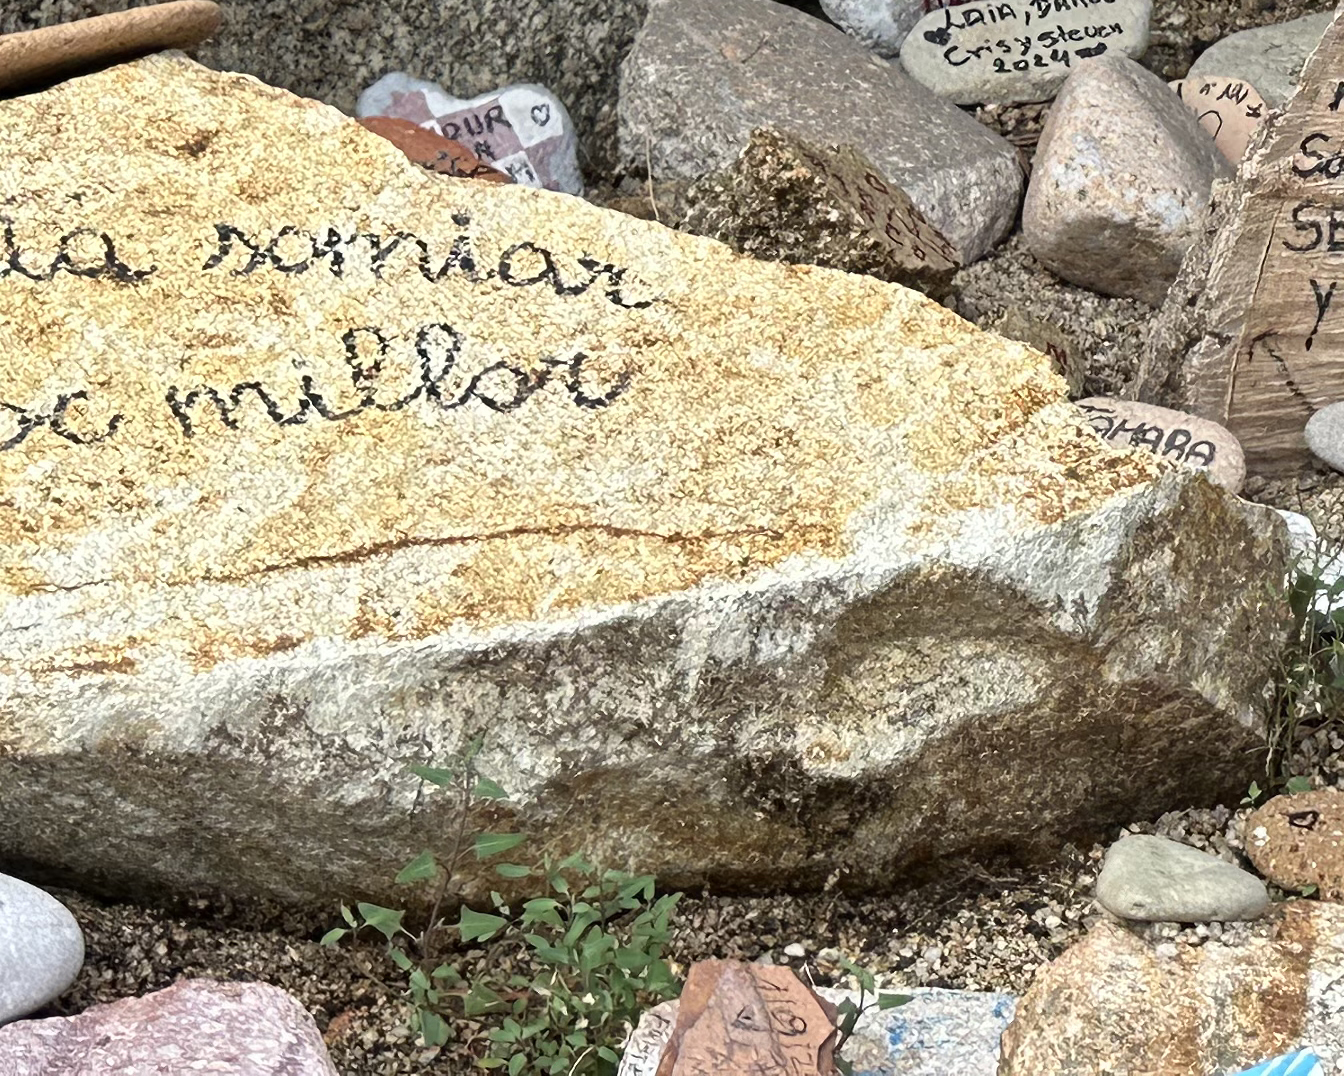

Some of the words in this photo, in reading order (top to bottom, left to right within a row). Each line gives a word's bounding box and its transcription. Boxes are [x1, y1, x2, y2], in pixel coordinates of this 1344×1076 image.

[993, 48, 1071, 74] 2024
[433, 105, 512, 141] OUR
[201, 209, 668, 310] somiar
[166, 324, 633, 438] millor
